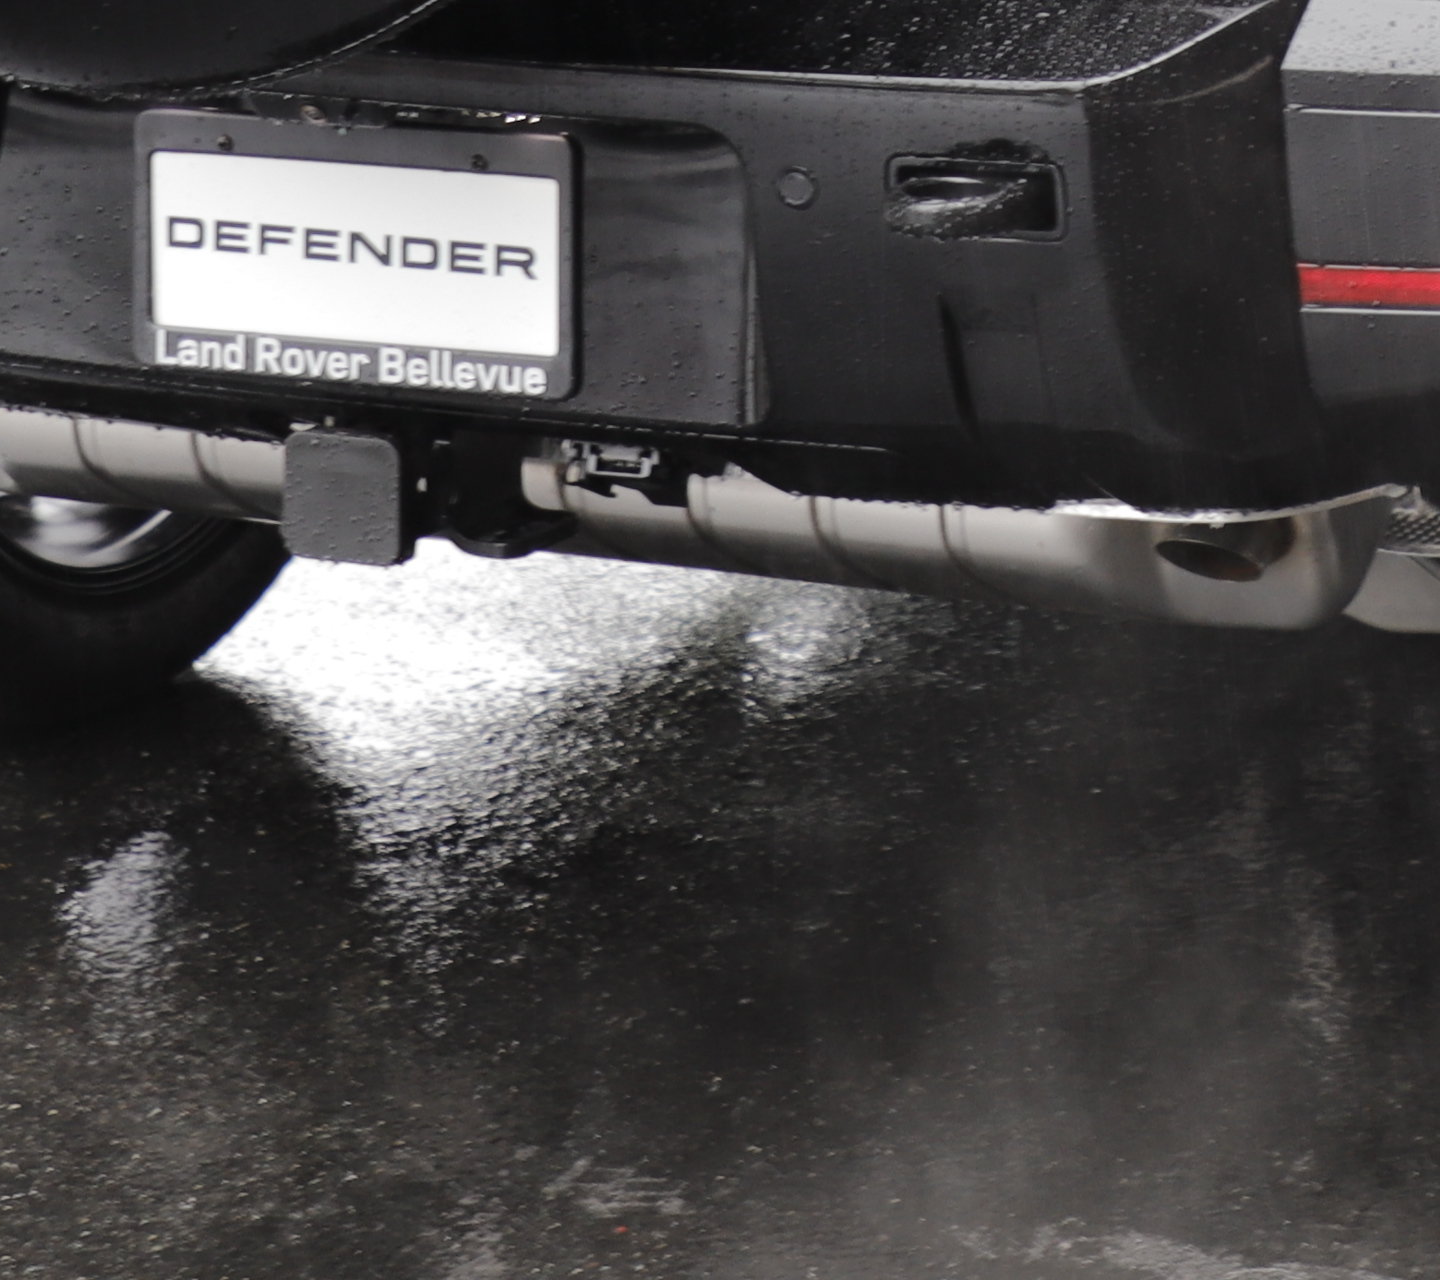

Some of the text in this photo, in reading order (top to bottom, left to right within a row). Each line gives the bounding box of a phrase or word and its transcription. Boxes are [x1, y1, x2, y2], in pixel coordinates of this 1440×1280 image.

[167, 216, 538, 279] DEFENDER
[155, 330, 548, 396] Land Rover Bellevue
